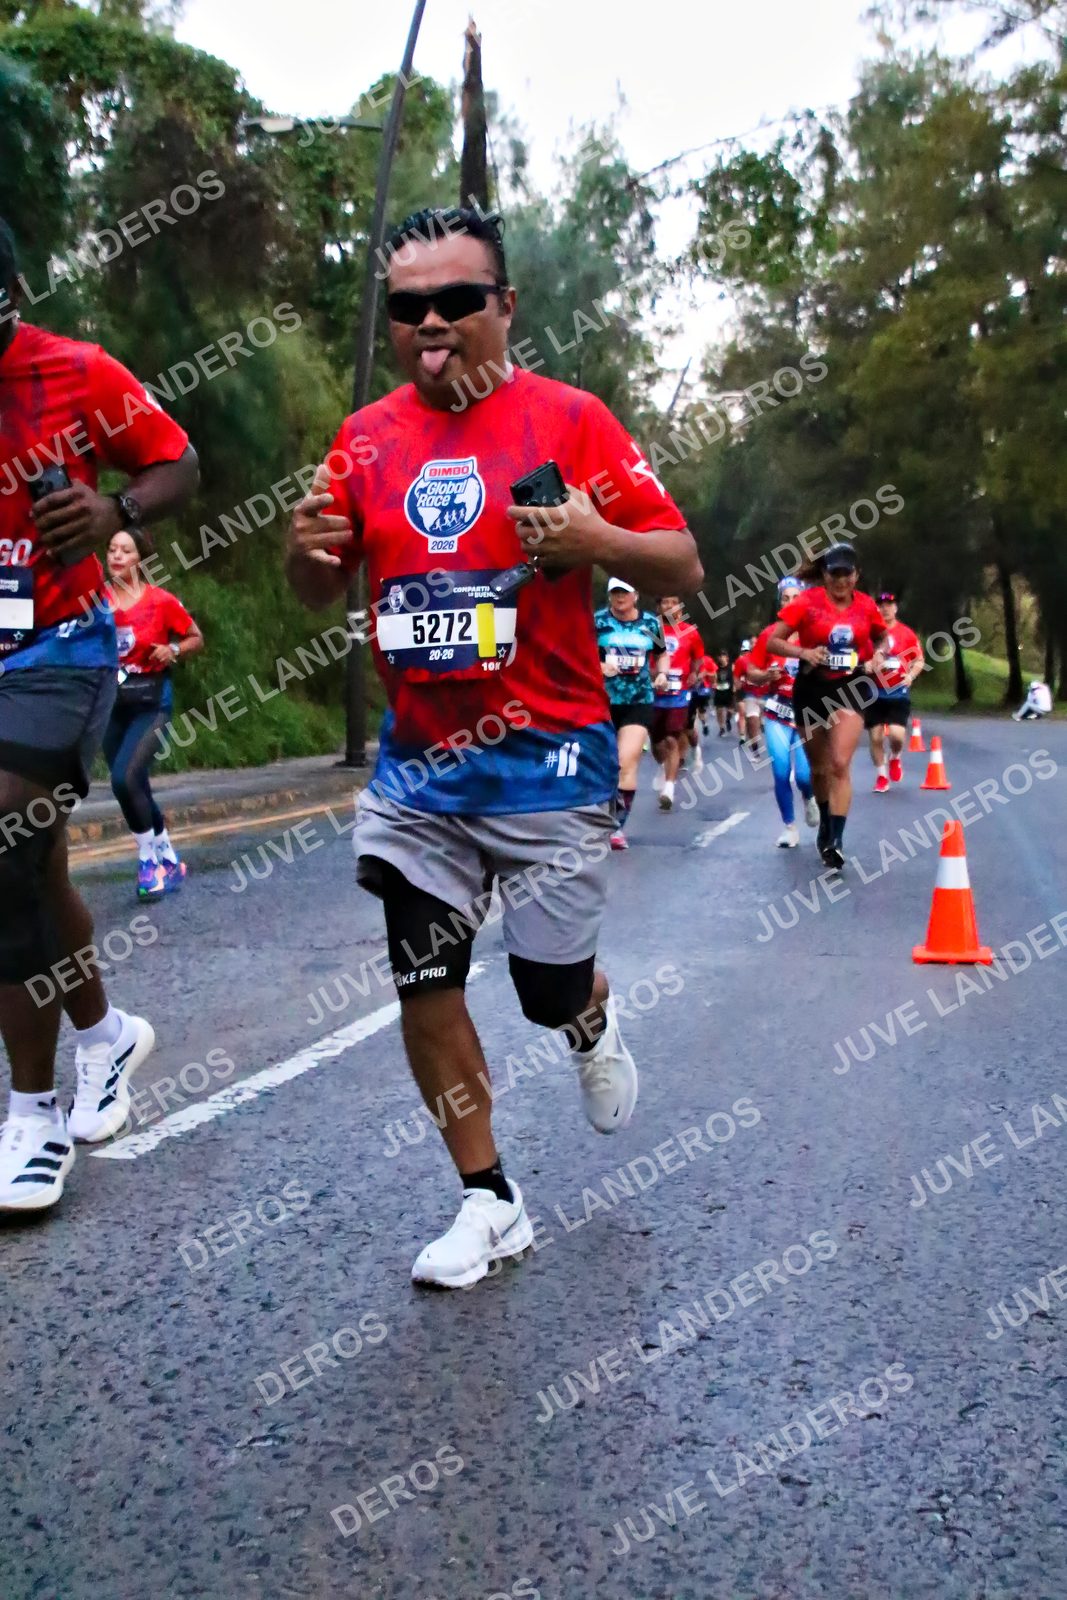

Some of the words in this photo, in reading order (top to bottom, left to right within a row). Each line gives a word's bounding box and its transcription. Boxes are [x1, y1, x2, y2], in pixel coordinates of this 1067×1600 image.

[429, 466, 469, 477] BIMBO
[427, 480, 467, 495] Global
[417, 493, 451, 507] Race
[431, 540, 455, 550] 2026
[412, 612, 472, 645] 5272
[420, 966, 447, 981] PRO
